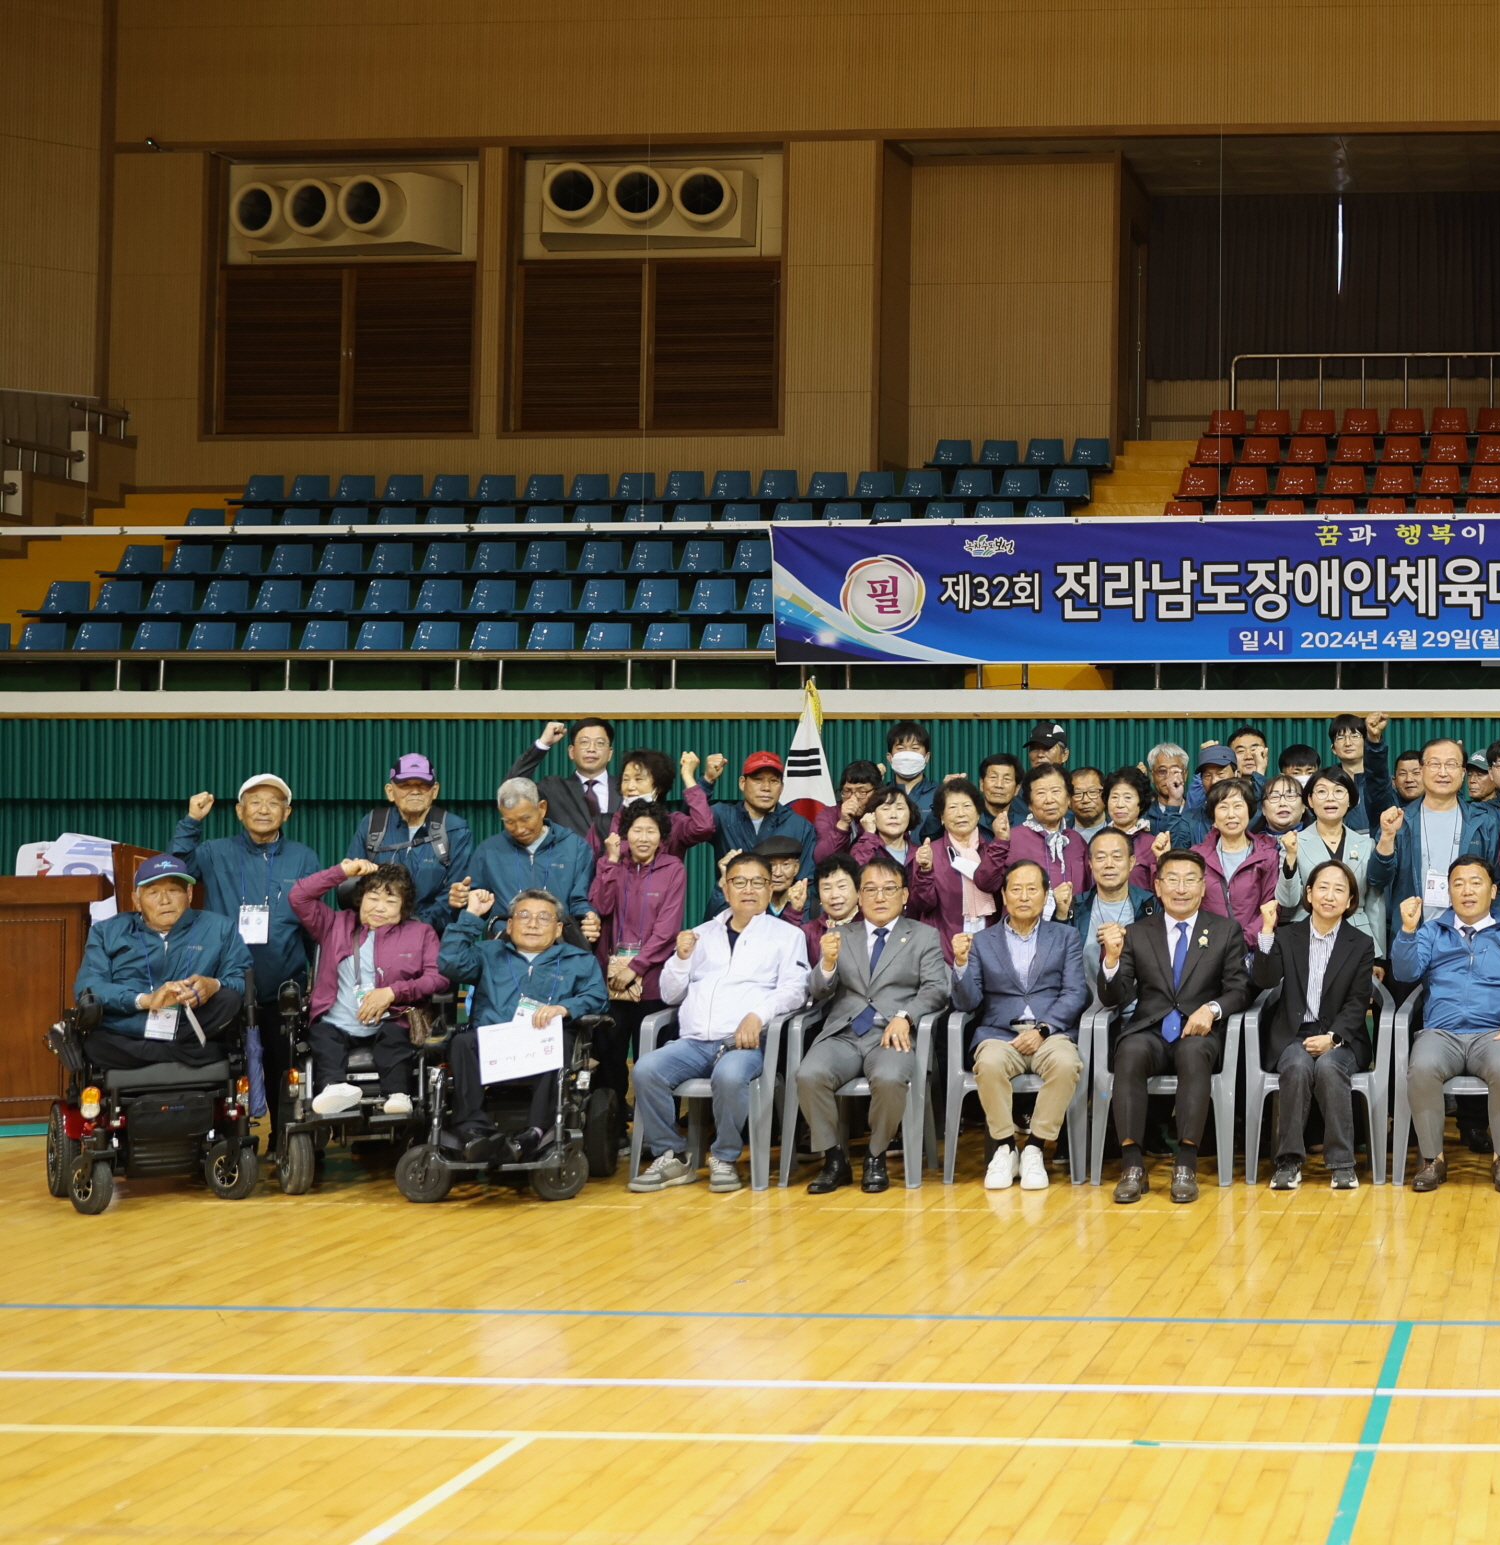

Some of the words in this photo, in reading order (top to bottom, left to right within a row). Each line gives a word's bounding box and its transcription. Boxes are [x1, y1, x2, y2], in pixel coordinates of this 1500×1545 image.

[1315, 524, 1377, 546] 꿈과
[1395, 523, 1485, 546] 행복이
[866, 575, 901, 614] 필
[940, 573, 1040, 611] 제32회
[1239, 630, 1284, 651] 일시
[1300, 630, 1378, 650] 2024년
[1382, 629, 1417, 650] 4월
